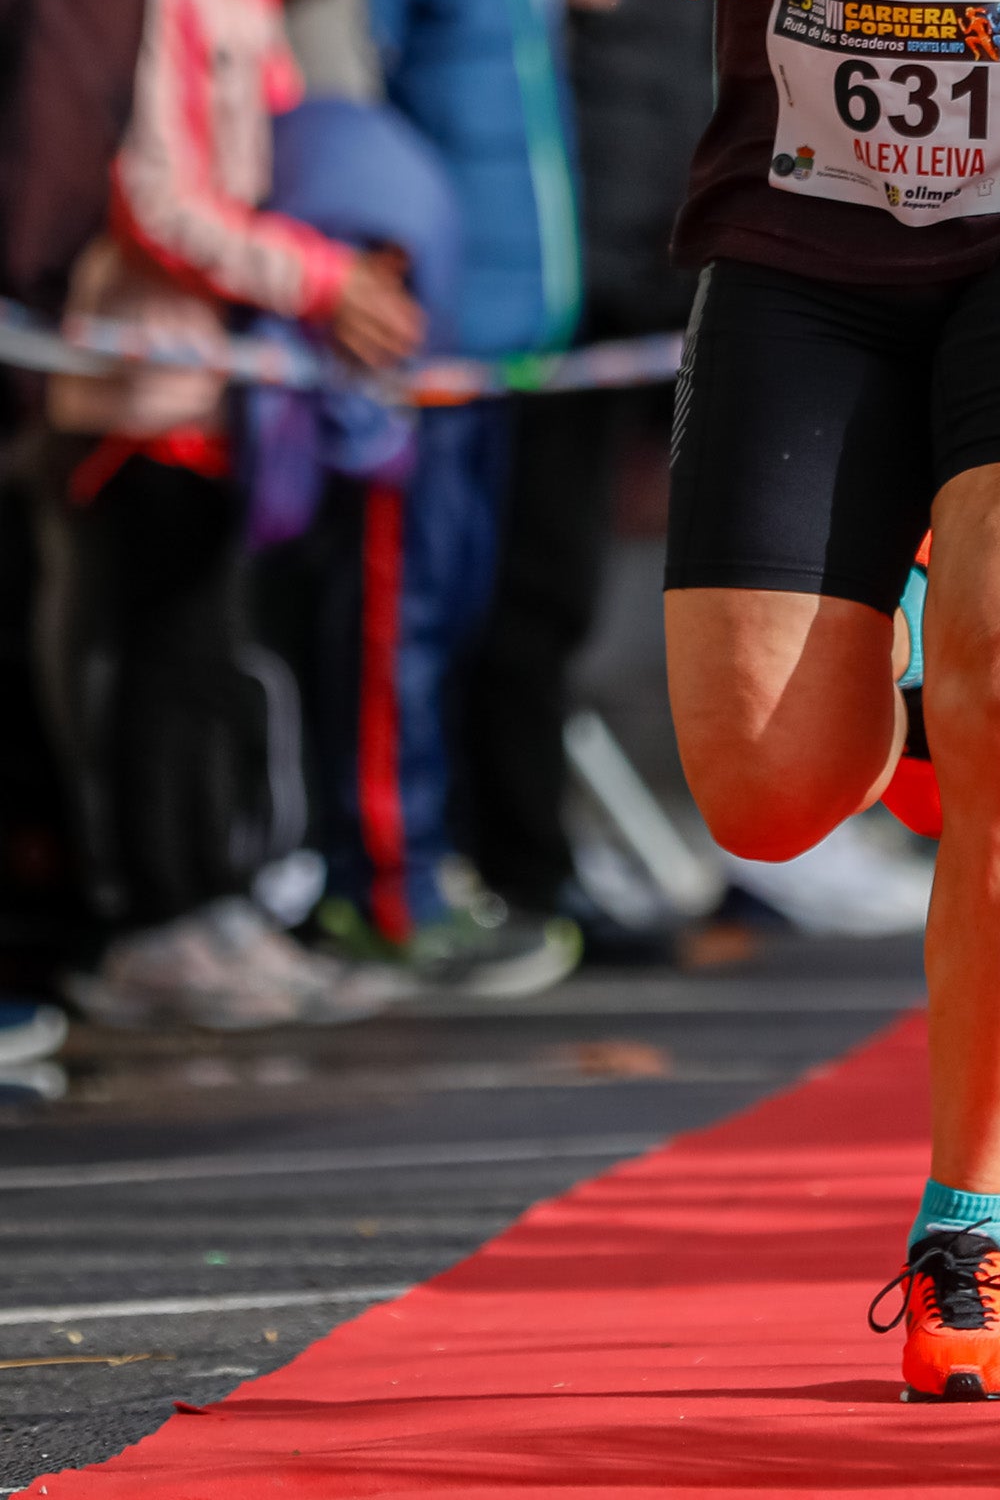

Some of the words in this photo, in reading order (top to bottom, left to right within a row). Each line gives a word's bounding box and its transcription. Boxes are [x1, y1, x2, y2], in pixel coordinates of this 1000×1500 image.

[844, 2, 958, 25] CARRERA
[845, 19, 957, 39] POPULAR
[783, 17, 807, 35] Ruta
[808, 25, 820, 39] de
[821, 29, 838, 45] los
[839, 33, 905, 52] Secaderos
[834, 59, 990, 140] 631
[853, 138, 909, 175] ALEX
[916, 145, 986, 178] LEIVA
